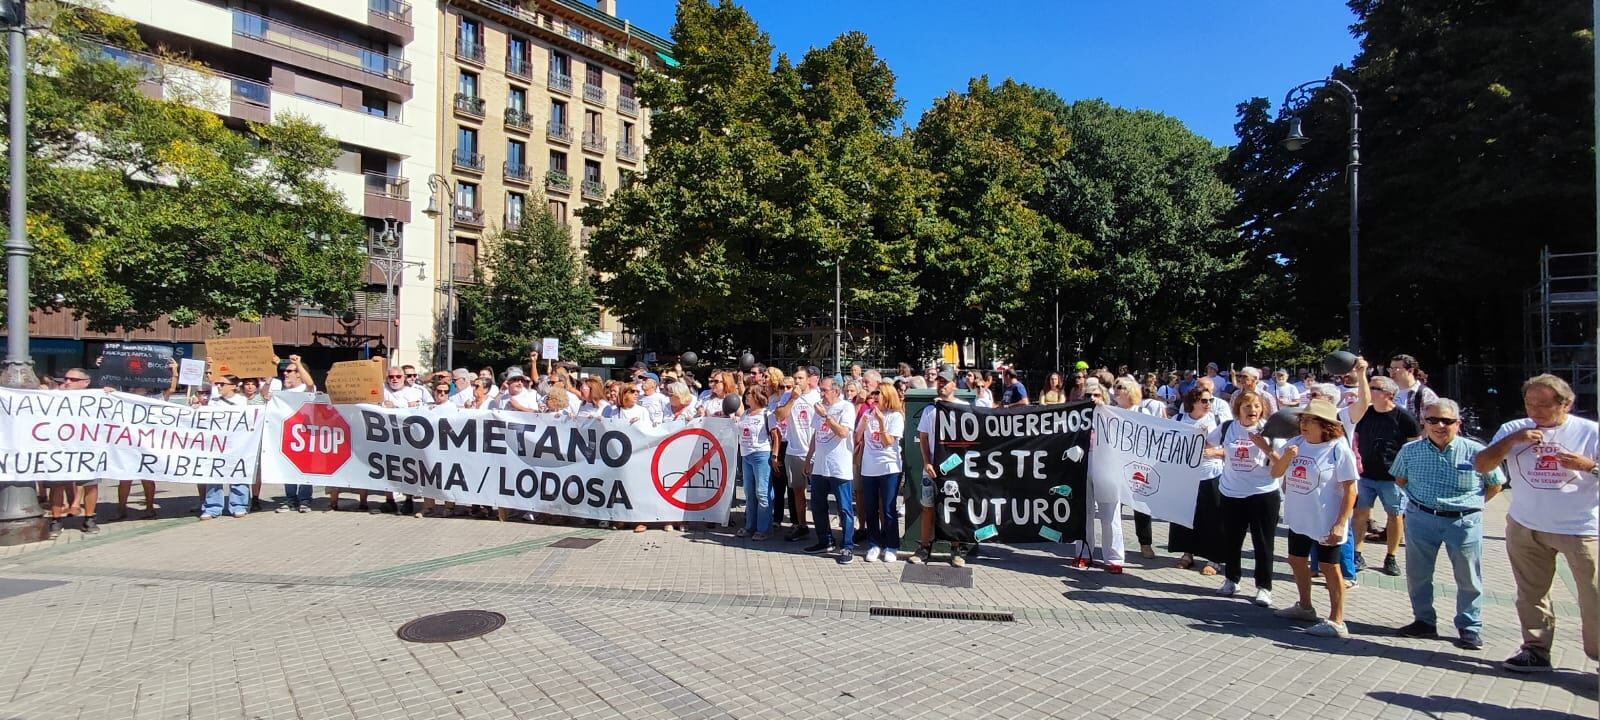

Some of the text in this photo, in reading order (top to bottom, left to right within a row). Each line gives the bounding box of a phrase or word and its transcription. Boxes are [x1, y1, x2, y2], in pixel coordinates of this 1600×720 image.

[0, 395, 259, 432] NAVARRA DESPIERTA!
[939, 408, 1093, 442] NO QUEREMOS
[32, 422, 227, 453] CONTAMINAN
[290, 423, 345, 454] STOP
[1096, 413, 1206, 469] NO BIOMETANO
[1531, 446, 1560, 454] STOP
[138, 453, 247, 478] RIBERA
[964, 450, 1048, 480] ESTE
[368, 452, 469, 493] SESMA
[499, 466, 633, 510] LODOSA
[943, 497, 1072, 526] FUTURO
